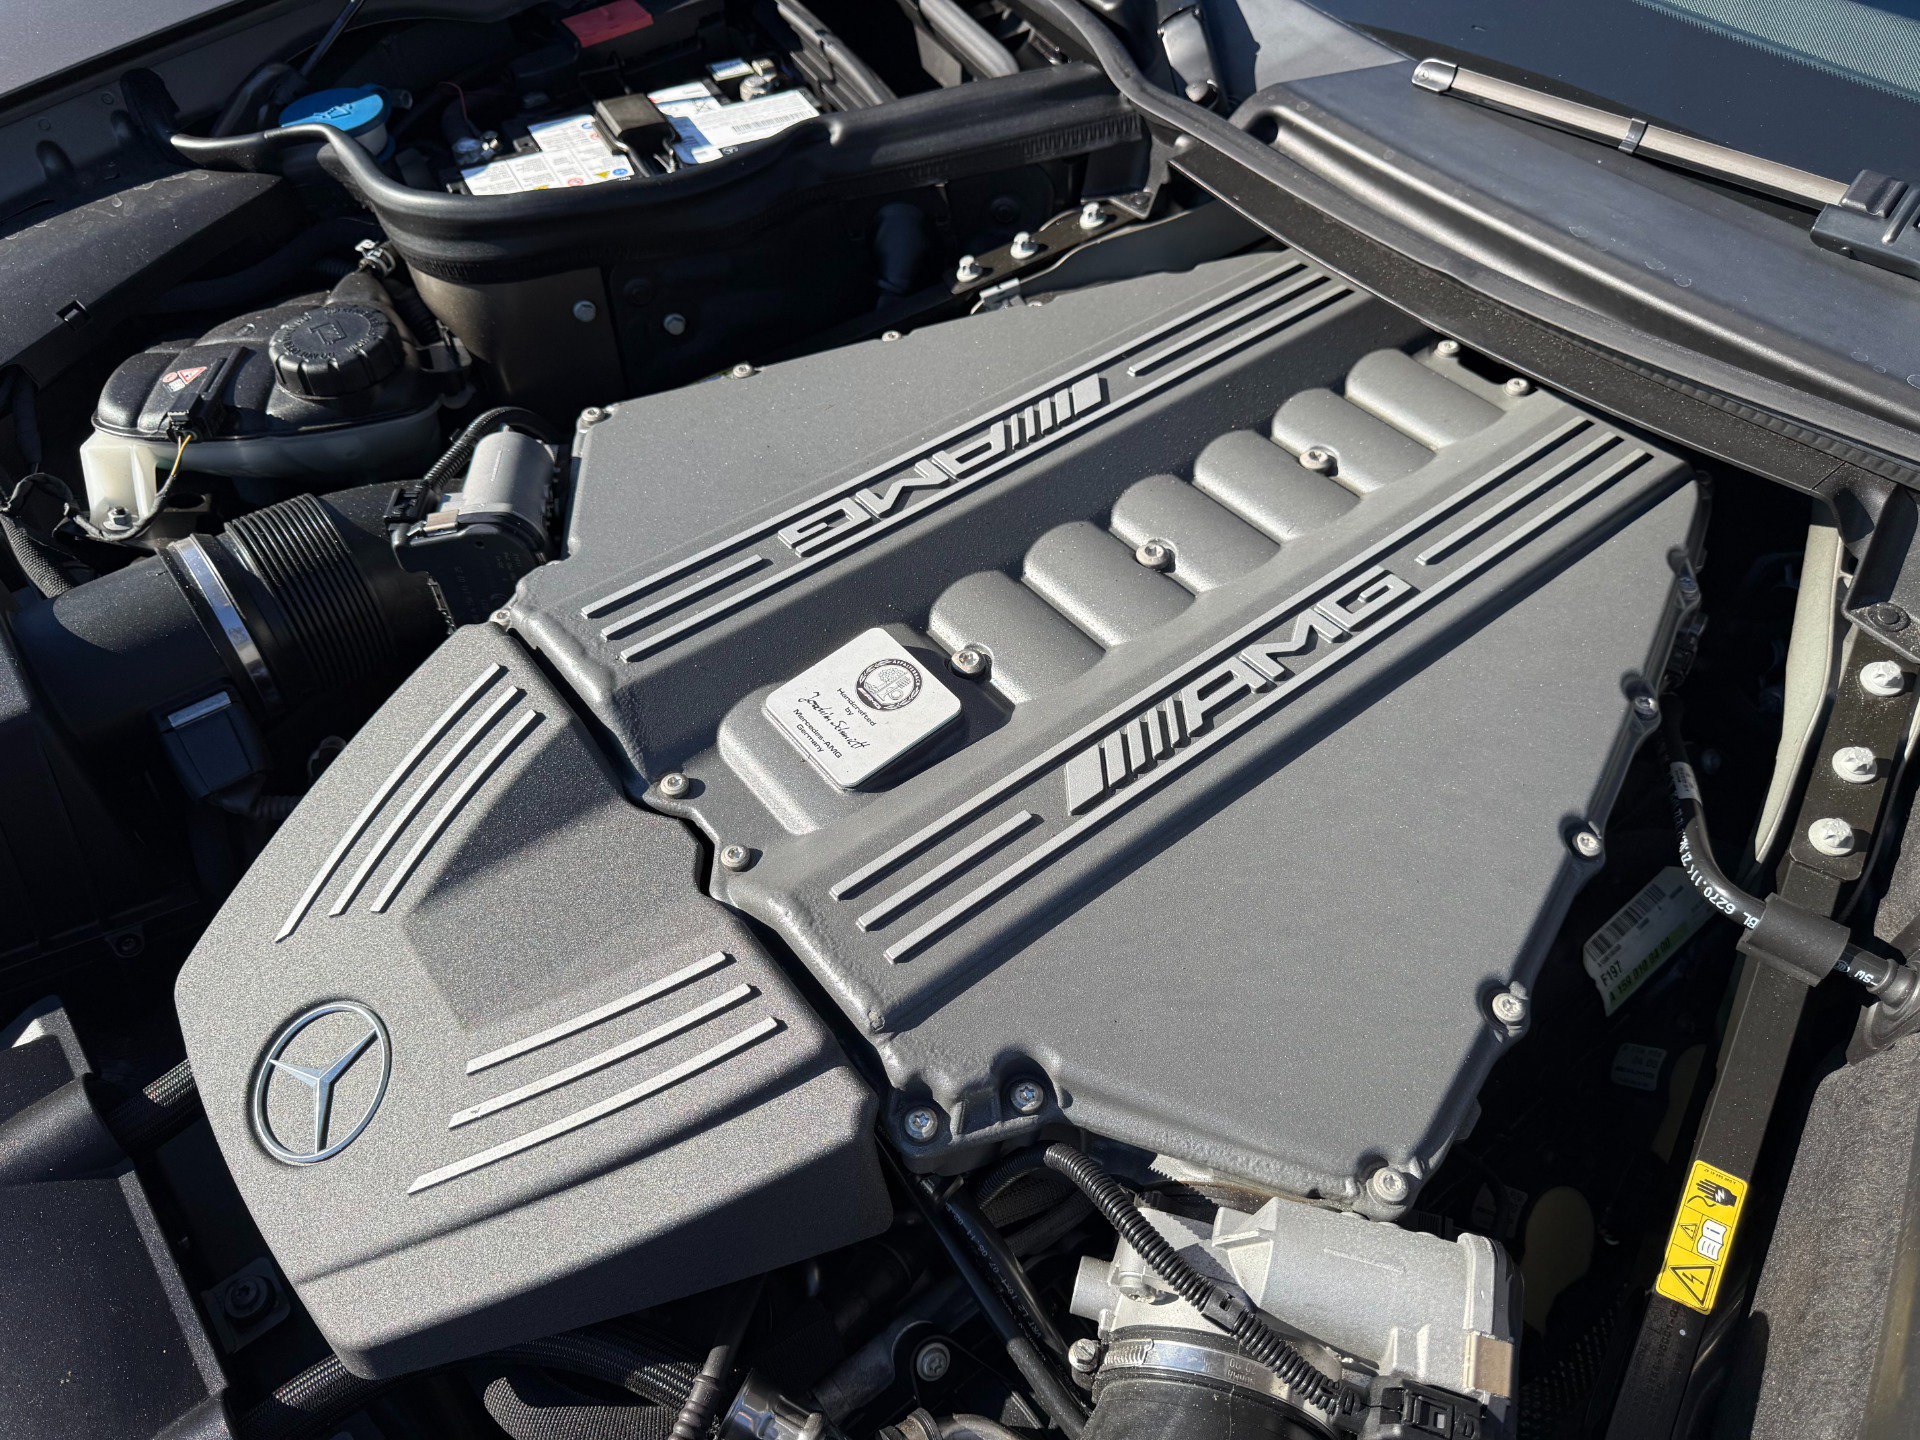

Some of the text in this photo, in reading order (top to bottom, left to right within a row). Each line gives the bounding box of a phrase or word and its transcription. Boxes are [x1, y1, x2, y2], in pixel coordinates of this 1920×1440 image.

[778, 420, 1006, 558] AMG
[1180, 564, 1414, 738] AMG
[837, 687, 877, 727] Handcrafted
[844, 706, 854, 716] by
[793, 708, 843, 759] Mercedes-AMG
[796, 723, 824, 753] Germany
[1600, 960, 1623, 987] F197
